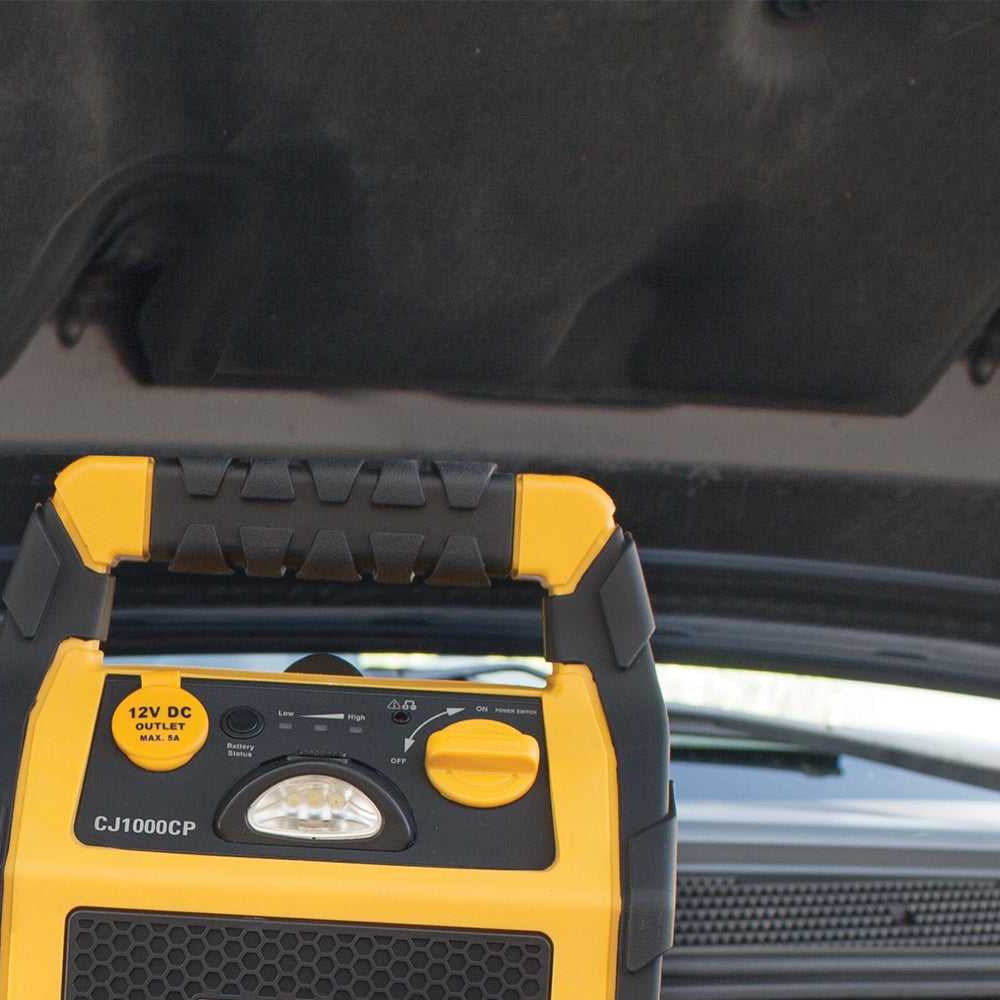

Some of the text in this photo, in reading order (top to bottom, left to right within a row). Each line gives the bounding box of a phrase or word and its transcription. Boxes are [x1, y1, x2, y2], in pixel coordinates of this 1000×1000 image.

[128, 706, 193, 719] 12V DC
[475, 705, 488, 713] ON
[494, 707, 516, 715] POWER
[278, 709, 366, 722] Low High
[134, 722, 186, 731] OUTLET
[139, 734, 180, 742] MAX. 5A
[226, 742, 255, 752] Battery
[227, 750, 253, 758] Status
[390, 757, 408, 765] OFF
[94, 815, 196, 837] CJ1000CP
